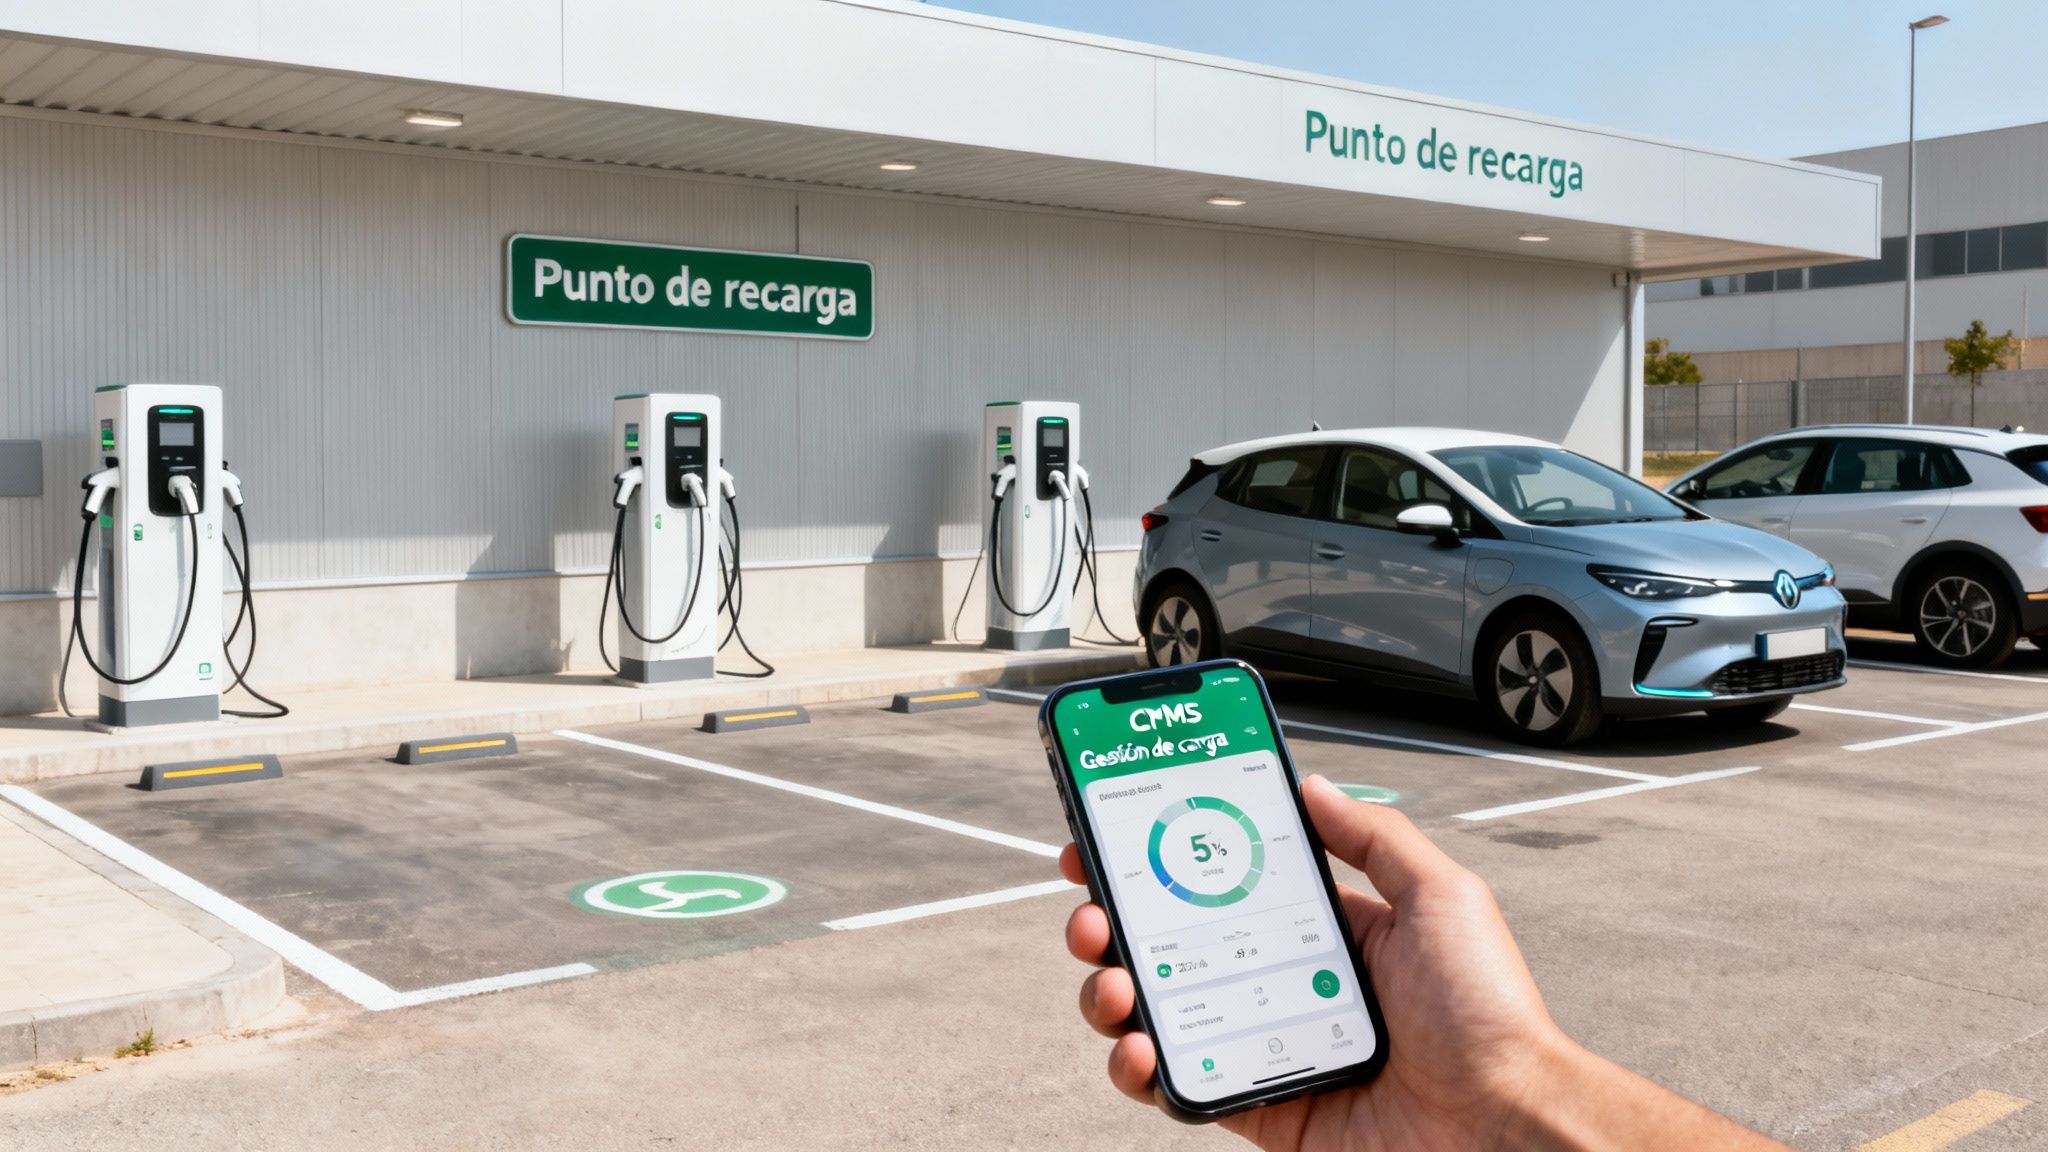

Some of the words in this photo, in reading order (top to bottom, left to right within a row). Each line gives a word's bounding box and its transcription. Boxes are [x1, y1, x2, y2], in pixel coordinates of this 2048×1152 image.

[1305, 109, 1406, 165] Punto
[1416, 127, 1458, 173] de
[1467, 144, 1584, 198] recarga
[534, 257, 655, 304] Punto
[665, 264, 712, 307] de
[724, 279, 857, 325] recarga
[1151, 735, 1175, 758] de
